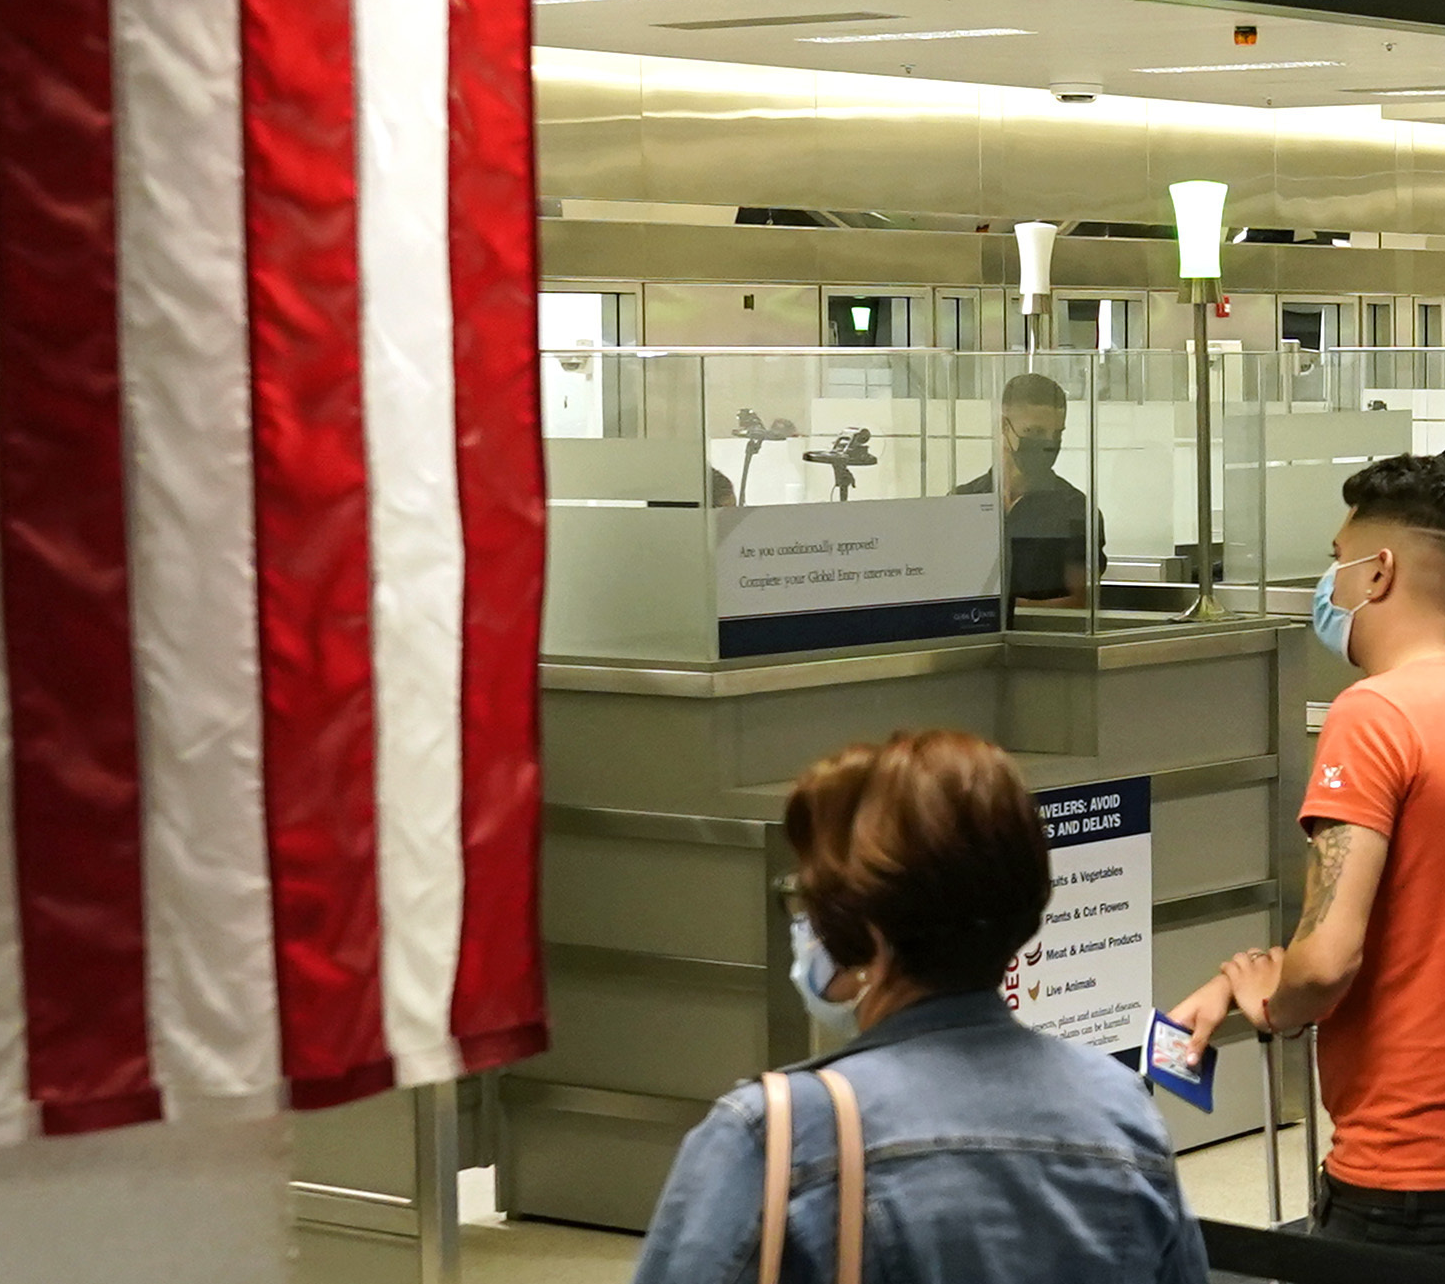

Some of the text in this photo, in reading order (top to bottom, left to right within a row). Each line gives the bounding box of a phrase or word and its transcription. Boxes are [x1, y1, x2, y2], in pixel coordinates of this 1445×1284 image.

[739, 546, 755, 558] Are
[758, 546, 774, 559] you
[739, 573, 782, 591] Complete
[784, 575, 805, 588] your
[808, 569, 835, 583] Global
[837, 569, 859, 582] Entry
[1036, 794, 1121, 819] AVELERS: AVOID
[1057, 820, 1080, 837] AND
[1082, 813, 1121, 833] DELAYS
[1071, 873, 1078, 884] &
[1079, 866, 1124, 883] Vegetables
[1045, 901, 1129, 924] Plants & Cut Flowers
[1045, 932, 1143, 961] Meat & Animal Products
[1046, 977, 1097, 997] Live Animals
[1077, 1009, 1090, 1021] and
[1091, 1005, 1114, 1018] animal
